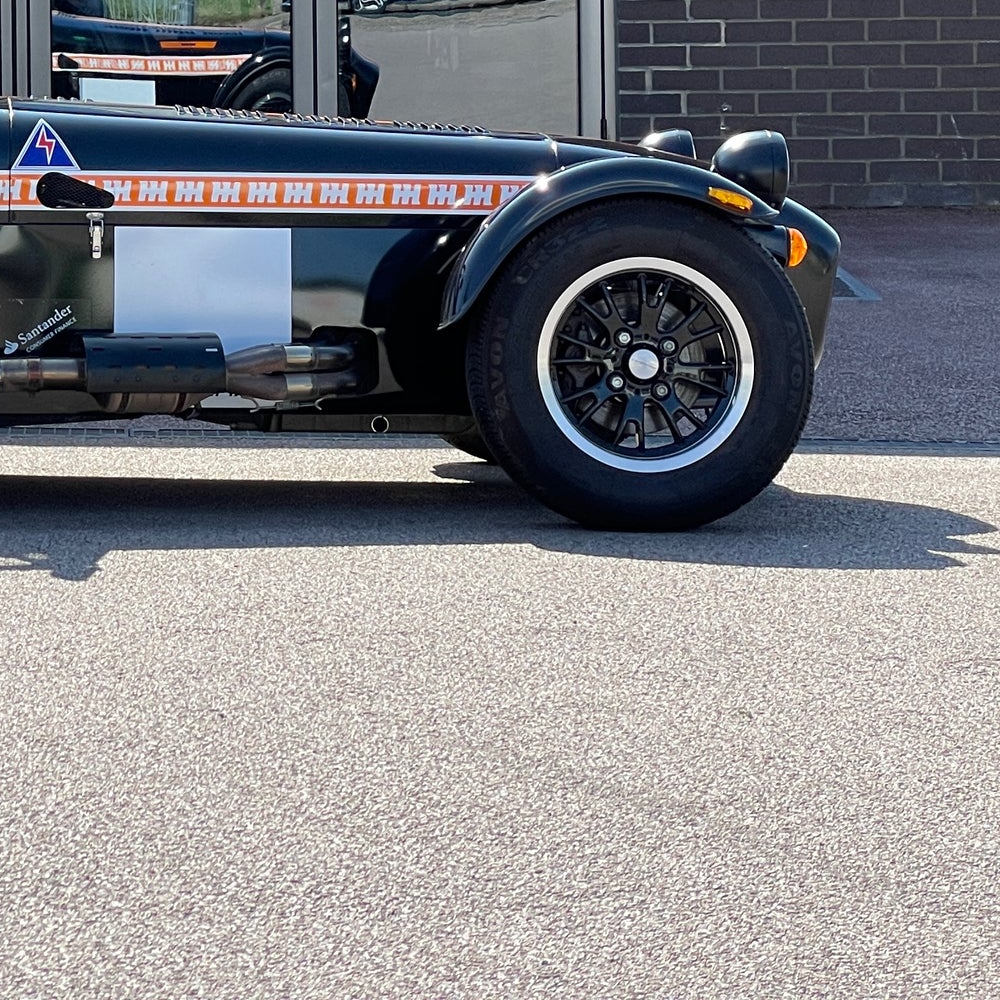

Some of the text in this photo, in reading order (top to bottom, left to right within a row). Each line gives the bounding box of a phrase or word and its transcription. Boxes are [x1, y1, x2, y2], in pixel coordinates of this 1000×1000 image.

[17, 304, 73, 345] Santander
[25, 316, 78, 353] CONSUMER FINANCE
